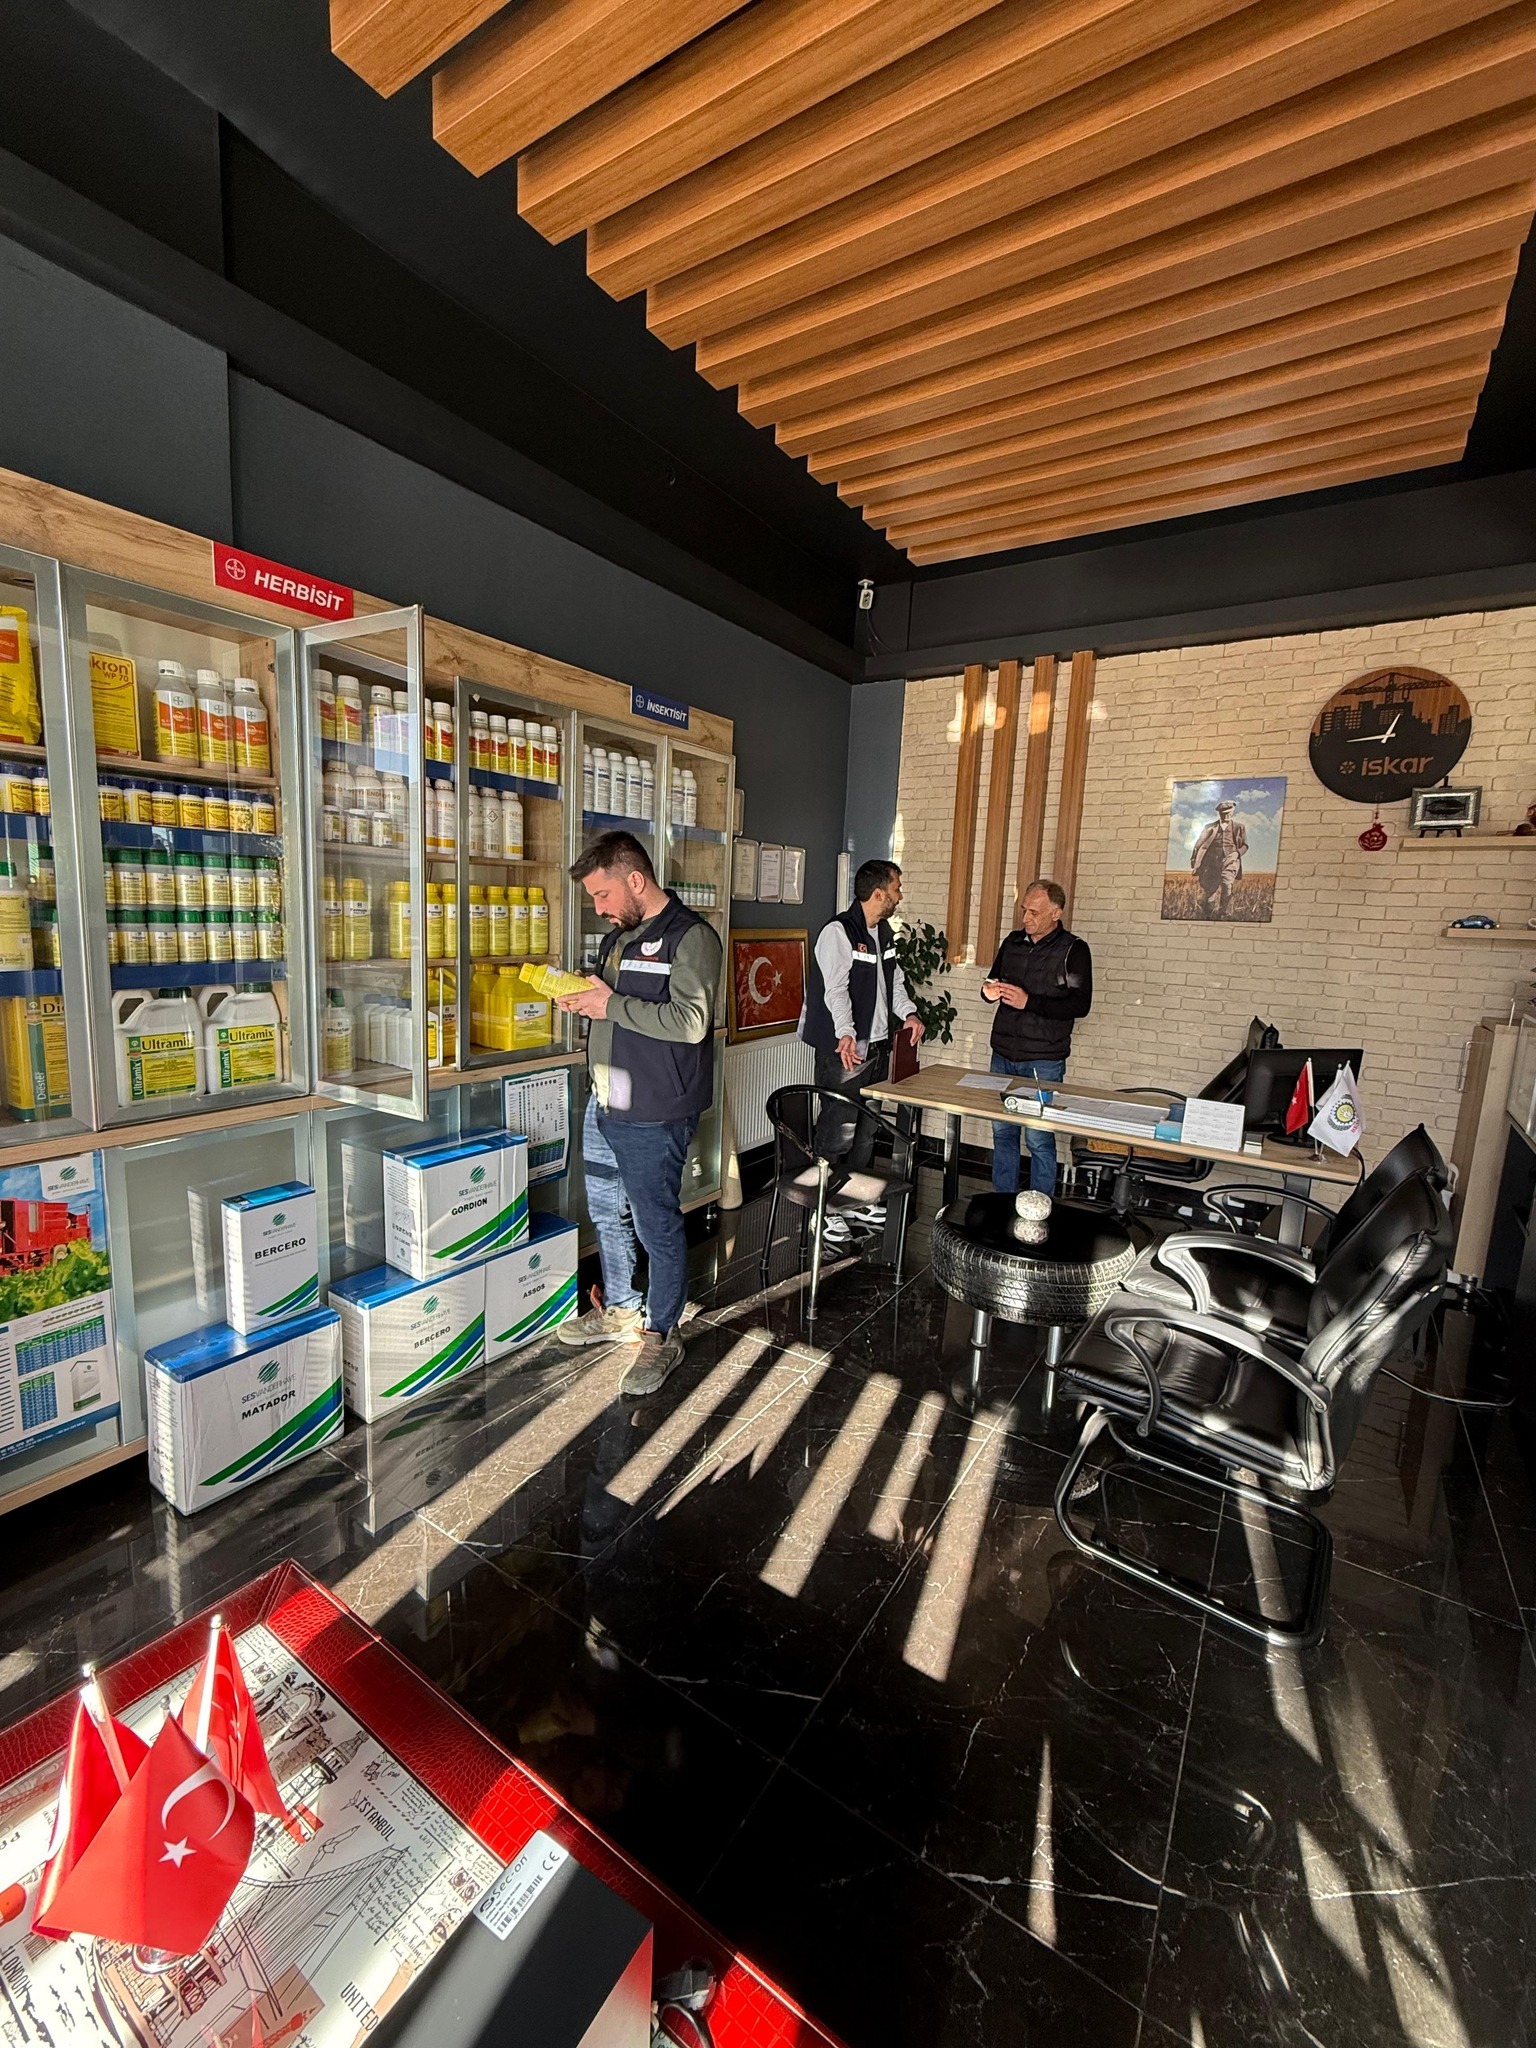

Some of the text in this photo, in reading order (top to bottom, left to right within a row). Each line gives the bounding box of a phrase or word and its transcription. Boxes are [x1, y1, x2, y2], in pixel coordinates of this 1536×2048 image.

[254, 569, 345, 611] HERBİSİT
[89, 655, 129, 675] kron
[103, 670, 117, 680] WP
[119, 674, 129, 683] 70
[646, 699, 688, 722] İNSEKTİSİT
[1361, 756, 1434, 777] iskar
[230, 1029, 274, 1042] Ultramix
[451, 1197, 488, 1216] GORDION
[254, 1237, 307, 1260] BERCERO
[522, 1283, 546, 1299] ASSOS
[414, 1326, 451, 1350] BERCERO
[241, 1389, 297, 1421] MATADOR
[354, 1795, 396, 1843] İSTANBUL
[492, 1854, 529, 1899] Sec-on
[340, 1980, 380, 2032] UNITED
